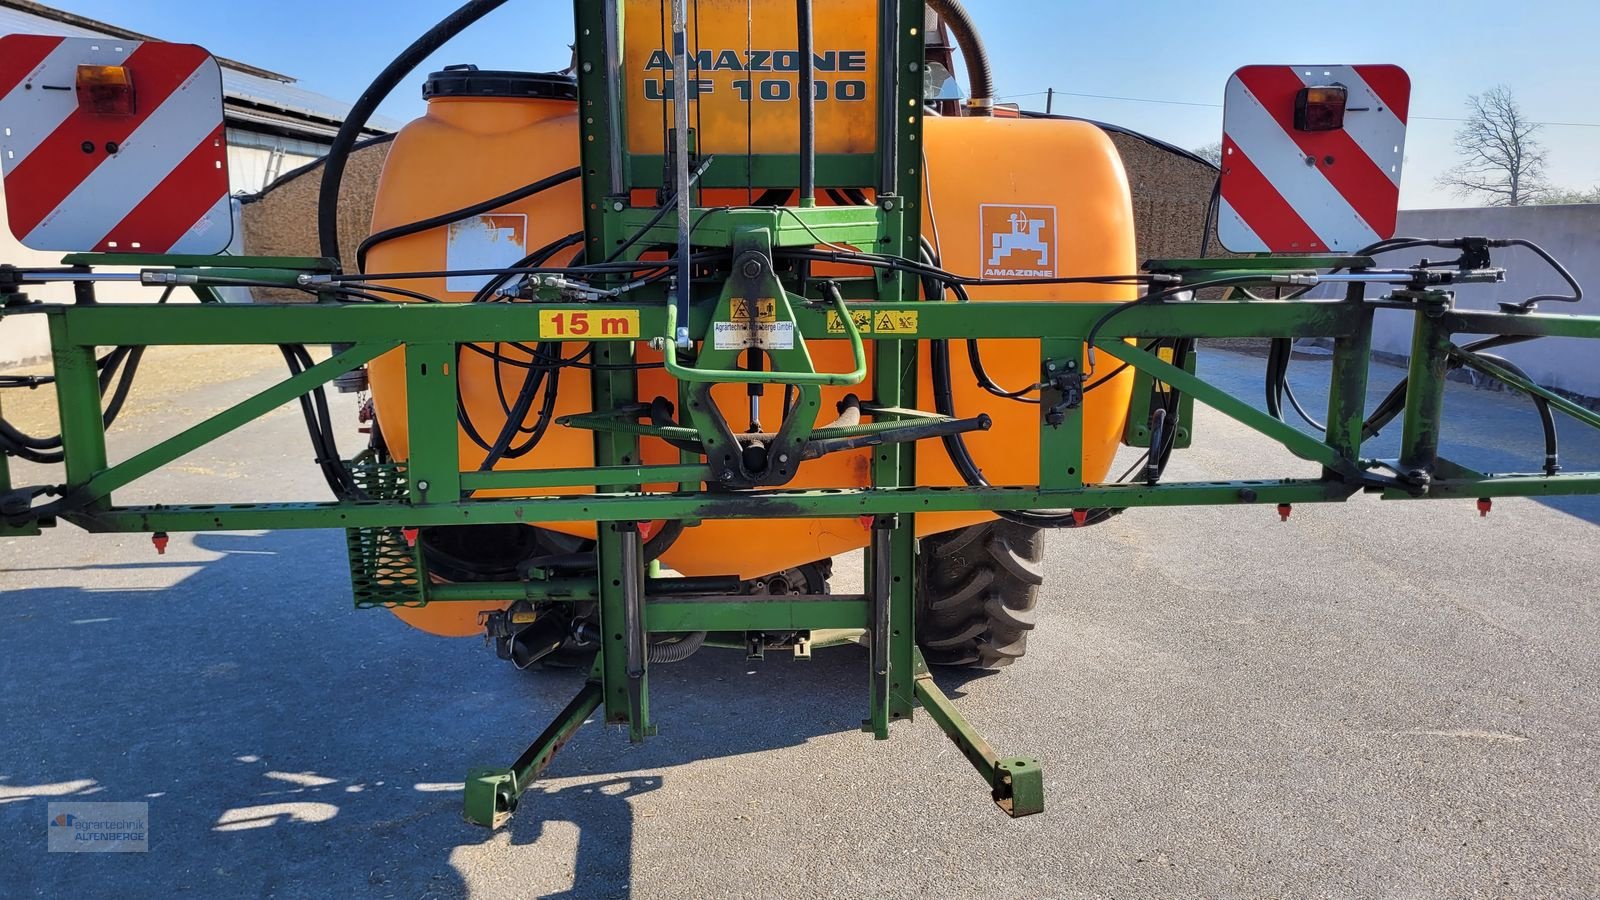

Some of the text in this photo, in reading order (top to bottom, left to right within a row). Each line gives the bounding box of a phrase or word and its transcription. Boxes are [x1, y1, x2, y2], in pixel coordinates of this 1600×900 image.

[643, 50, 866, 72] AMAZONE
[643, 79, 714, 101] UF
[984, 269, 1053, 277] AMAZONE
[551, 313, 630, 335] 15 m
[777, 322, 793, 331] GmbH
